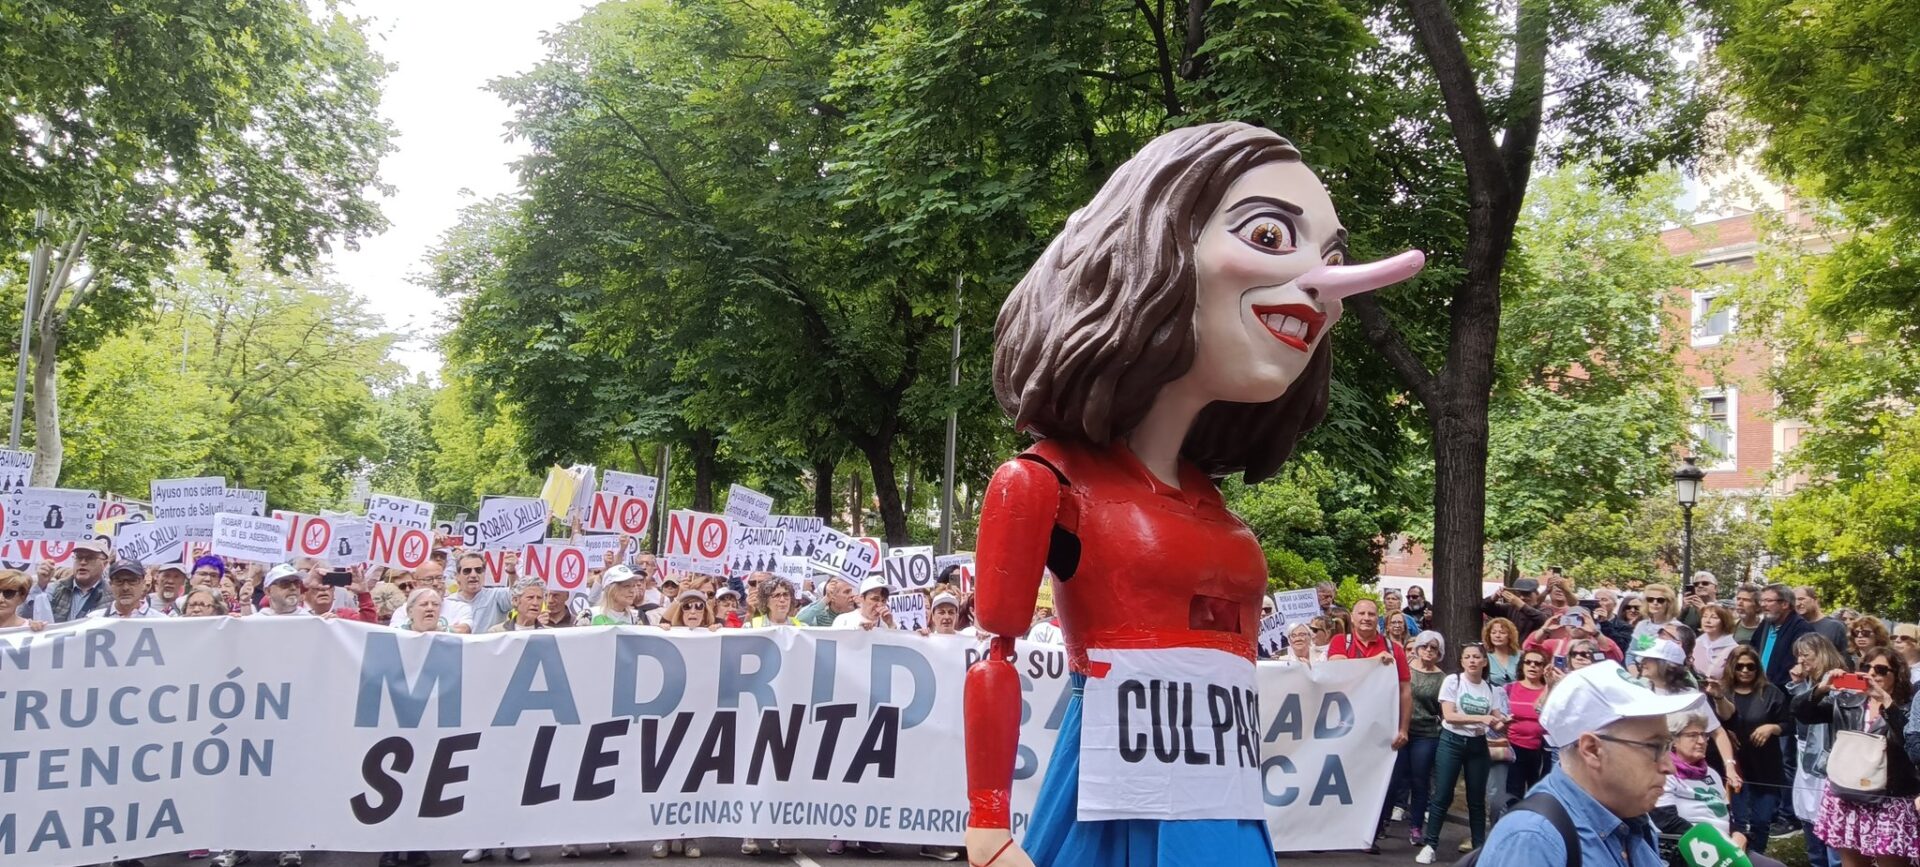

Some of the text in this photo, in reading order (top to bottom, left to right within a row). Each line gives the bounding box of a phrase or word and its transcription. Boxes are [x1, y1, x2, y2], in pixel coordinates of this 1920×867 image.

[184, 487, 198, 497] nos
[201, 484, 223, 496] cierra
[155, 506, 186, 519] Centros
[188, 504, 197, 516] de
[414, 504, 430, 517] la
[590, 493, 649, 534] NO
[784, 517, 822, 533] SANIDAD
[369, 522, 429, 569] NO
[667, 513, 728, 559] NO
[748, 528, 785, 547] SANIDAD
[817, 532, 854, 552] ¡Por
[858, 546, 872, 564] la
[525, 545, 586, 589] NO
[812, 549, 868, 581] SALUD!
[885, 554, 931, 588] NO
[890, 594, 924, 614] ANIDAD
[1260, 612, 1286, 635] ANIDAD
[1027, 650, 1064, 679] SU
[354, 632, 936, 730] MADRID
[0, 667, 291, 731] RUCCIÓN
[350, 732, 481, 825] SE
[521, 703, 900, 806] LEVANTA
[650, 800, 743, 826] VECINAS
[750, 801, 764, 824] Y
[768, 801, 857, 829] VECINOS
[865, 806, 892, 830] DE
